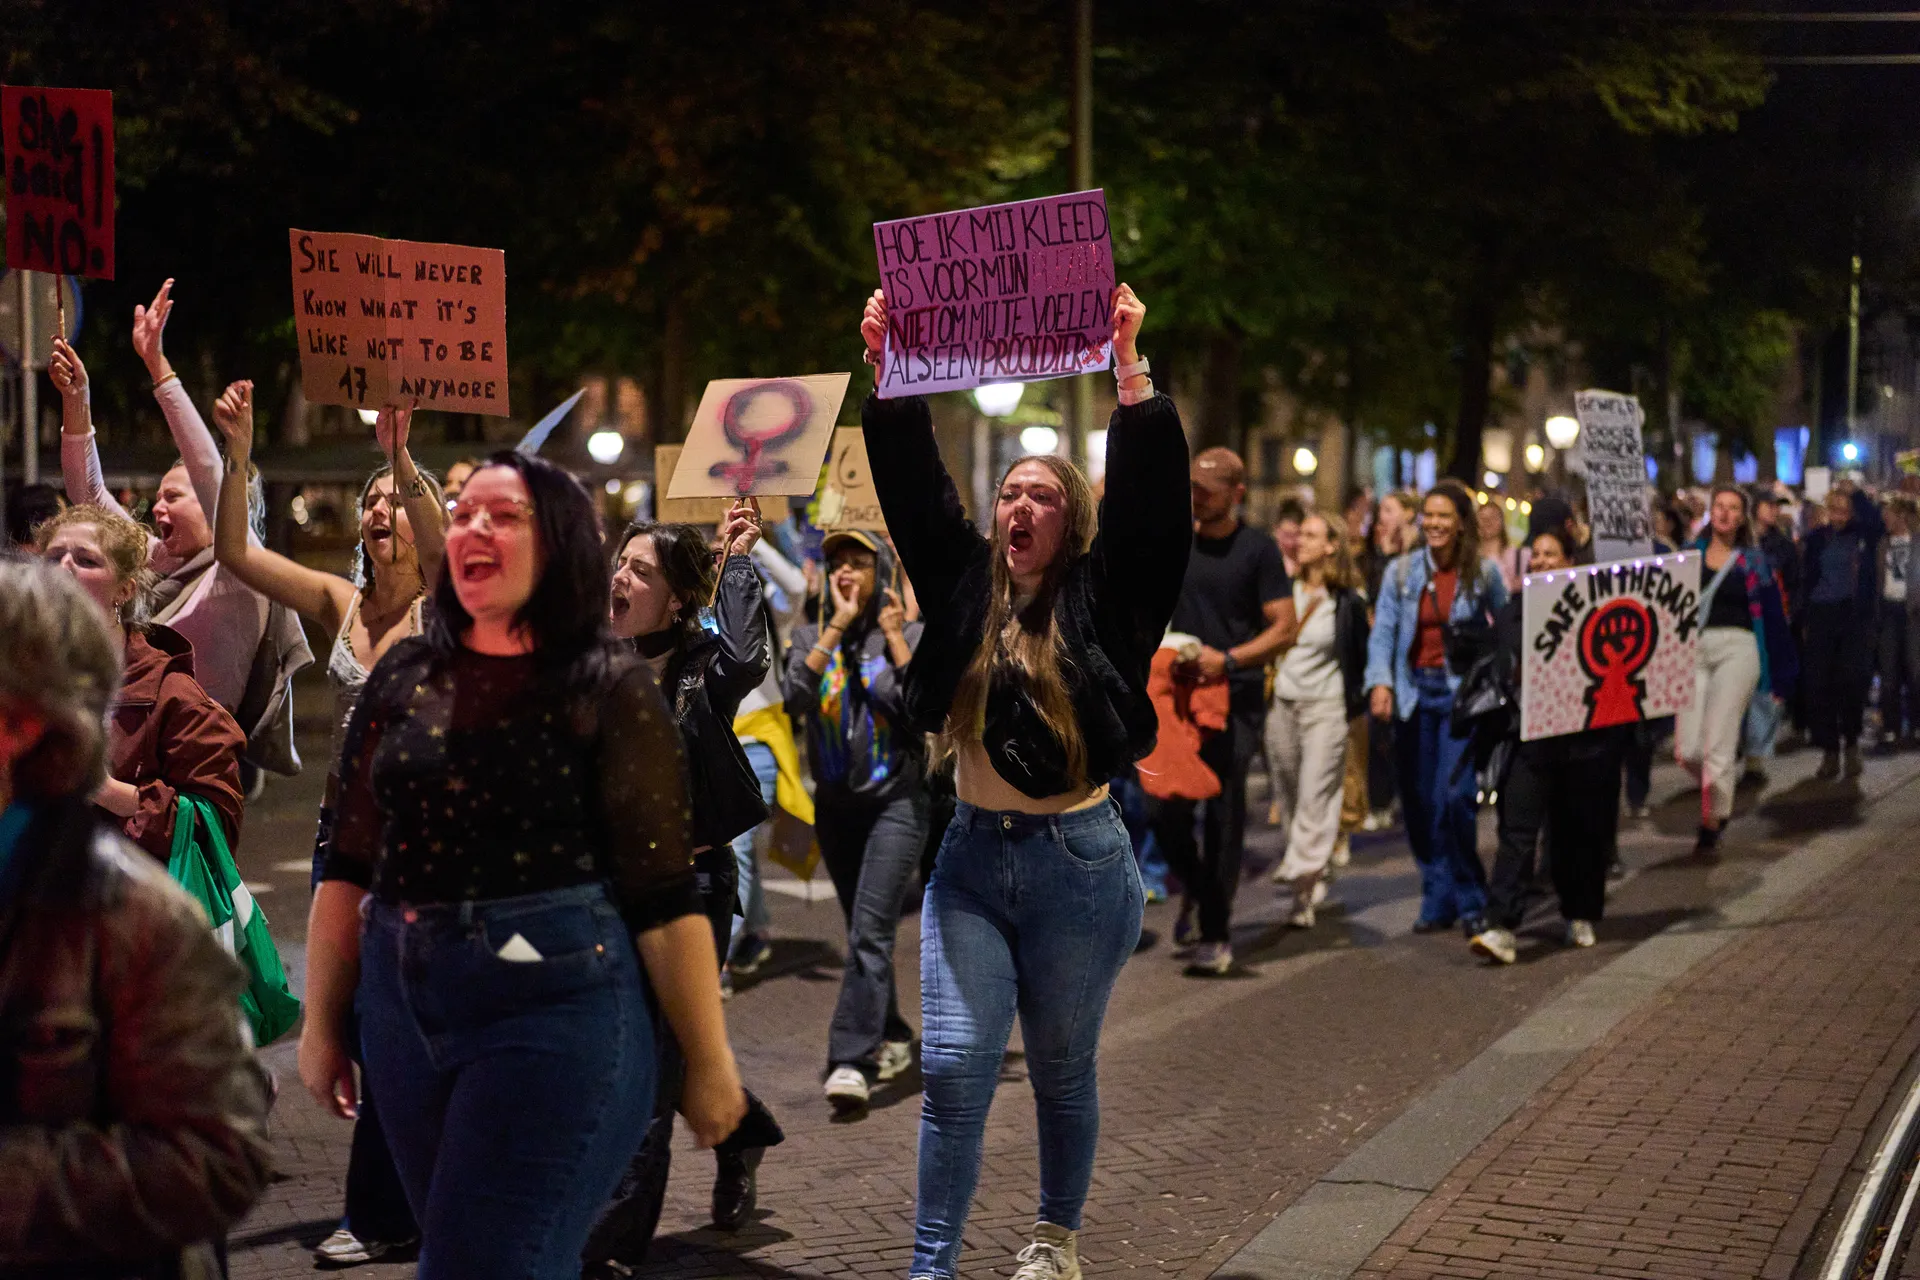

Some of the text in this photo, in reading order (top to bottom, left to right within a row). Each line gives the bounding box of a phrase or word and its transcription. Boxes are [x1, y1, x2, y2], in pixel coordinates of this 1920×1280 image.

[19, 94, 78, 161] She
[298, 235, 340, 273] SHE
[415, 260, 483, 285] NEVER
[878, 201, 1107, 266] HOE IK MIJ KLEED
[303, 288, 346, 317] KNOW
[360, 298, 418, 320] WHAT
[884, 267, 913, 310] IS
[917, 258, 982, 304] VOOR
[982, 251, 1029, 298] MIJN
[888, 288, 1113, 351] NIET OM MIJ TE VOELEN
[367, 338, 404, 361] NOT
[419, 338, 448, 361] TO
[457, 340, 493, 362] BE
[885, 331, 1086, 387] ALS EEN PROOIDIER
[338, 364, 496, 404] 17 ANYMORE
[1534, 582, 1586, 664] SAFE
[1587, 568, 1613, 602] IN
[1655, 572, 1700, 643] DARK
